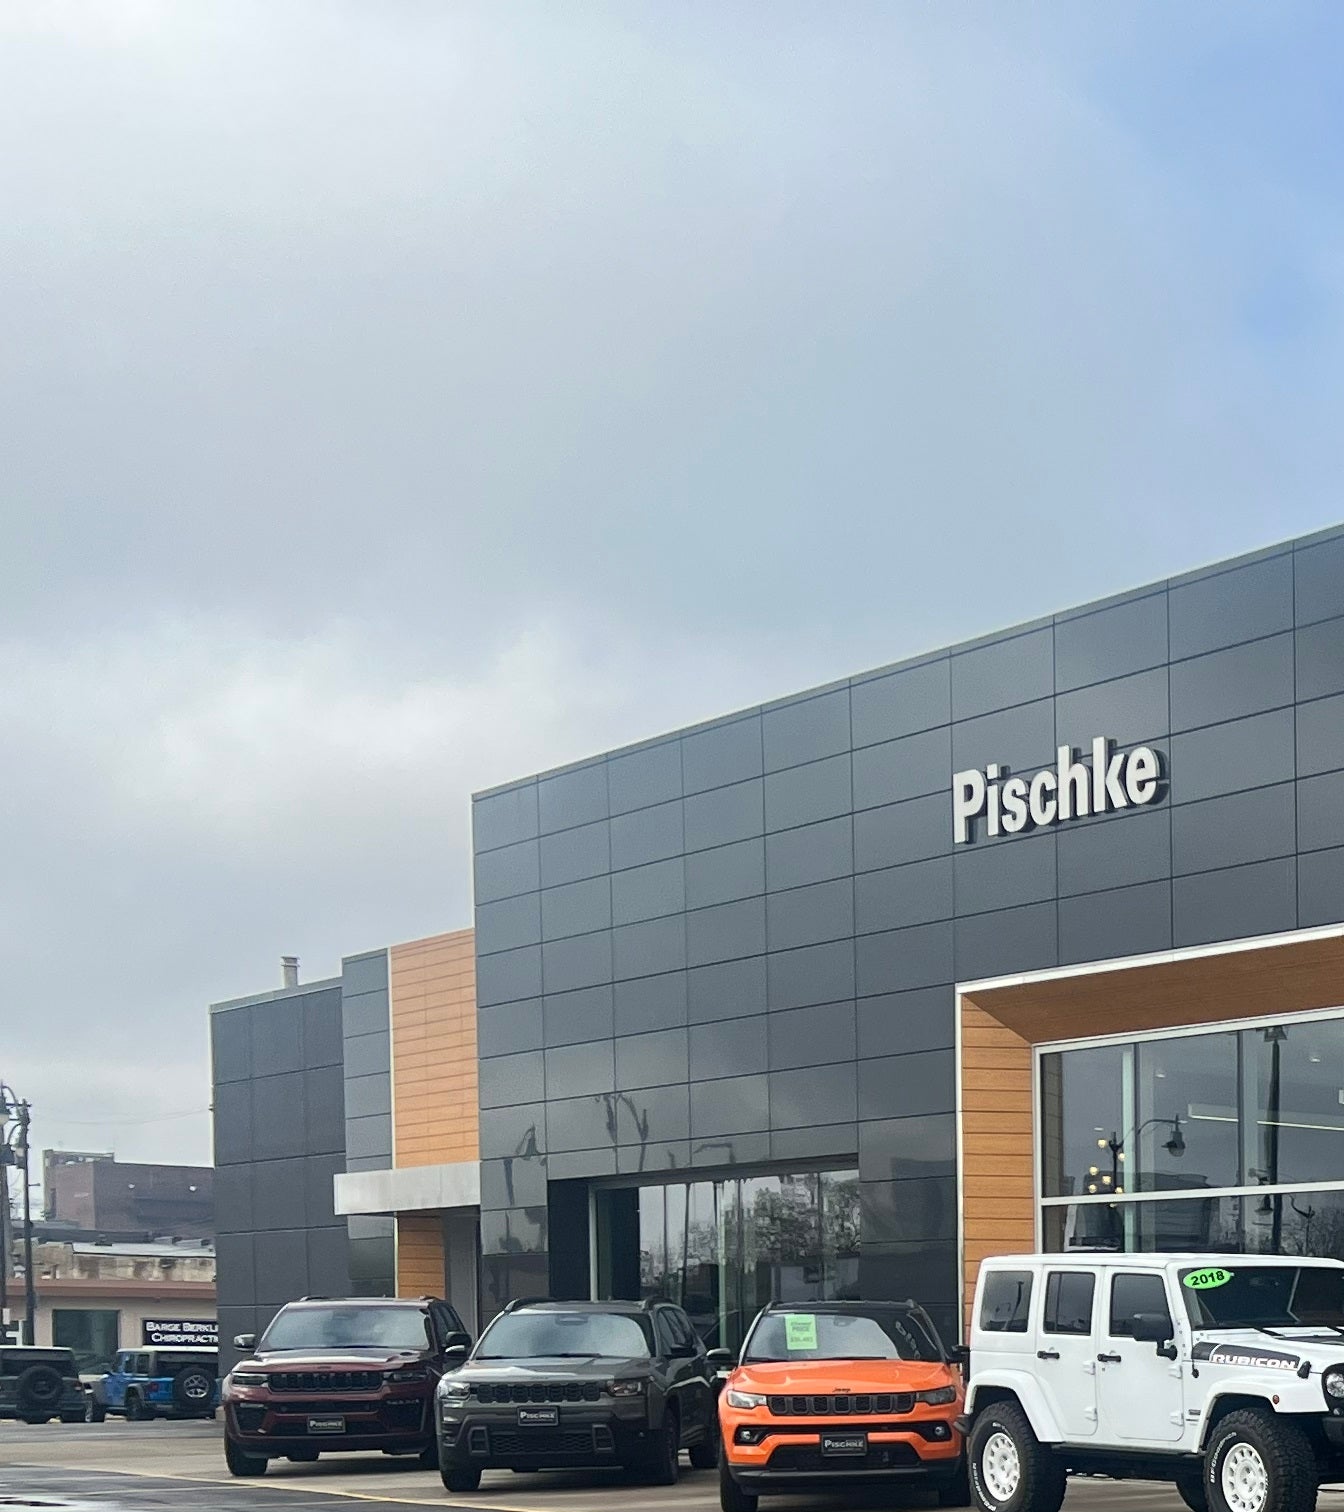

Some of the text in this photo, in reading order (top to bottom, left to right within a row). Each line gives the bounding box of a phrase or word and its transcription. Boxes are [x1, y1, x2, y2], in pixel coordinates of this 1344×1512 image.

[952, 736, 1161, 844] Pischke
[1191, 1270, 1225, 1286] 2018
[182, 1323, 218, 1333] BERKL
[1212, 1354, 1297, 1370] RUBICON
